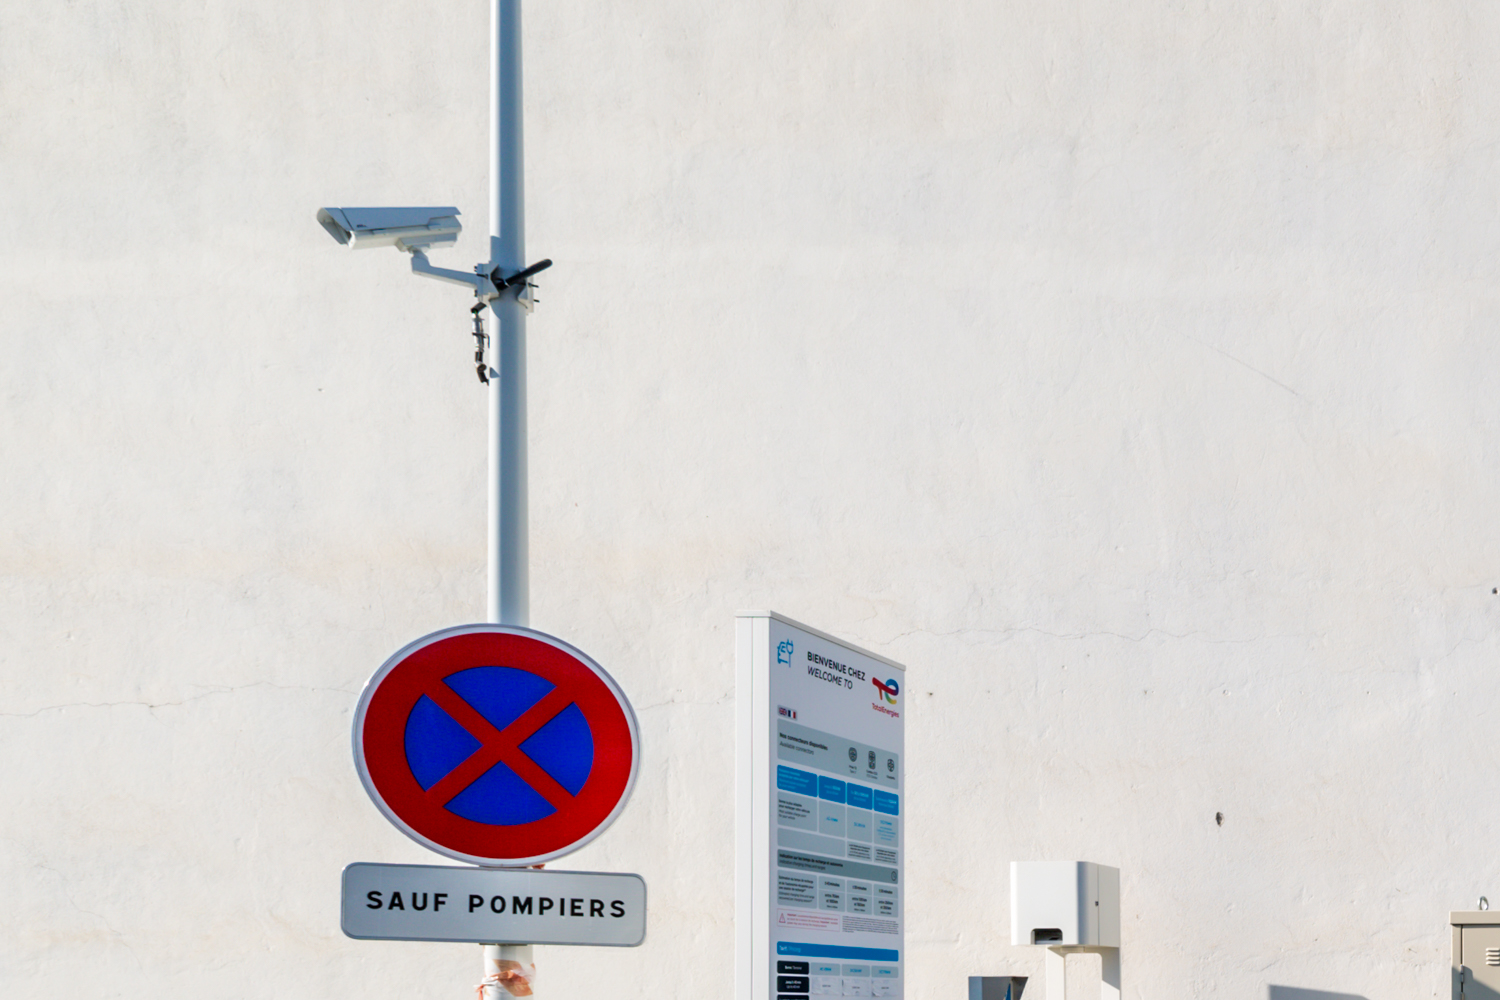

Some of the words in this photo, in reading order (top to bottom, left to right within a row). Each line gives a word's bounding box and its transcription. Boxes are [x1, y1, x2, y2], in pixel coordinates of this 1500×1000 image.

[807, 651, 847, 675] BIENVENUE
[848, 667, 866, 681] CHEZ
[807, 666, 841, 686] WELCOME
[844, 679, 853, 689] TO
[872, 703, 899, 718] TotalEnergies
[366, 891, 449, 912] SAUF
[468, 894, 626, 918] POMPIERS
